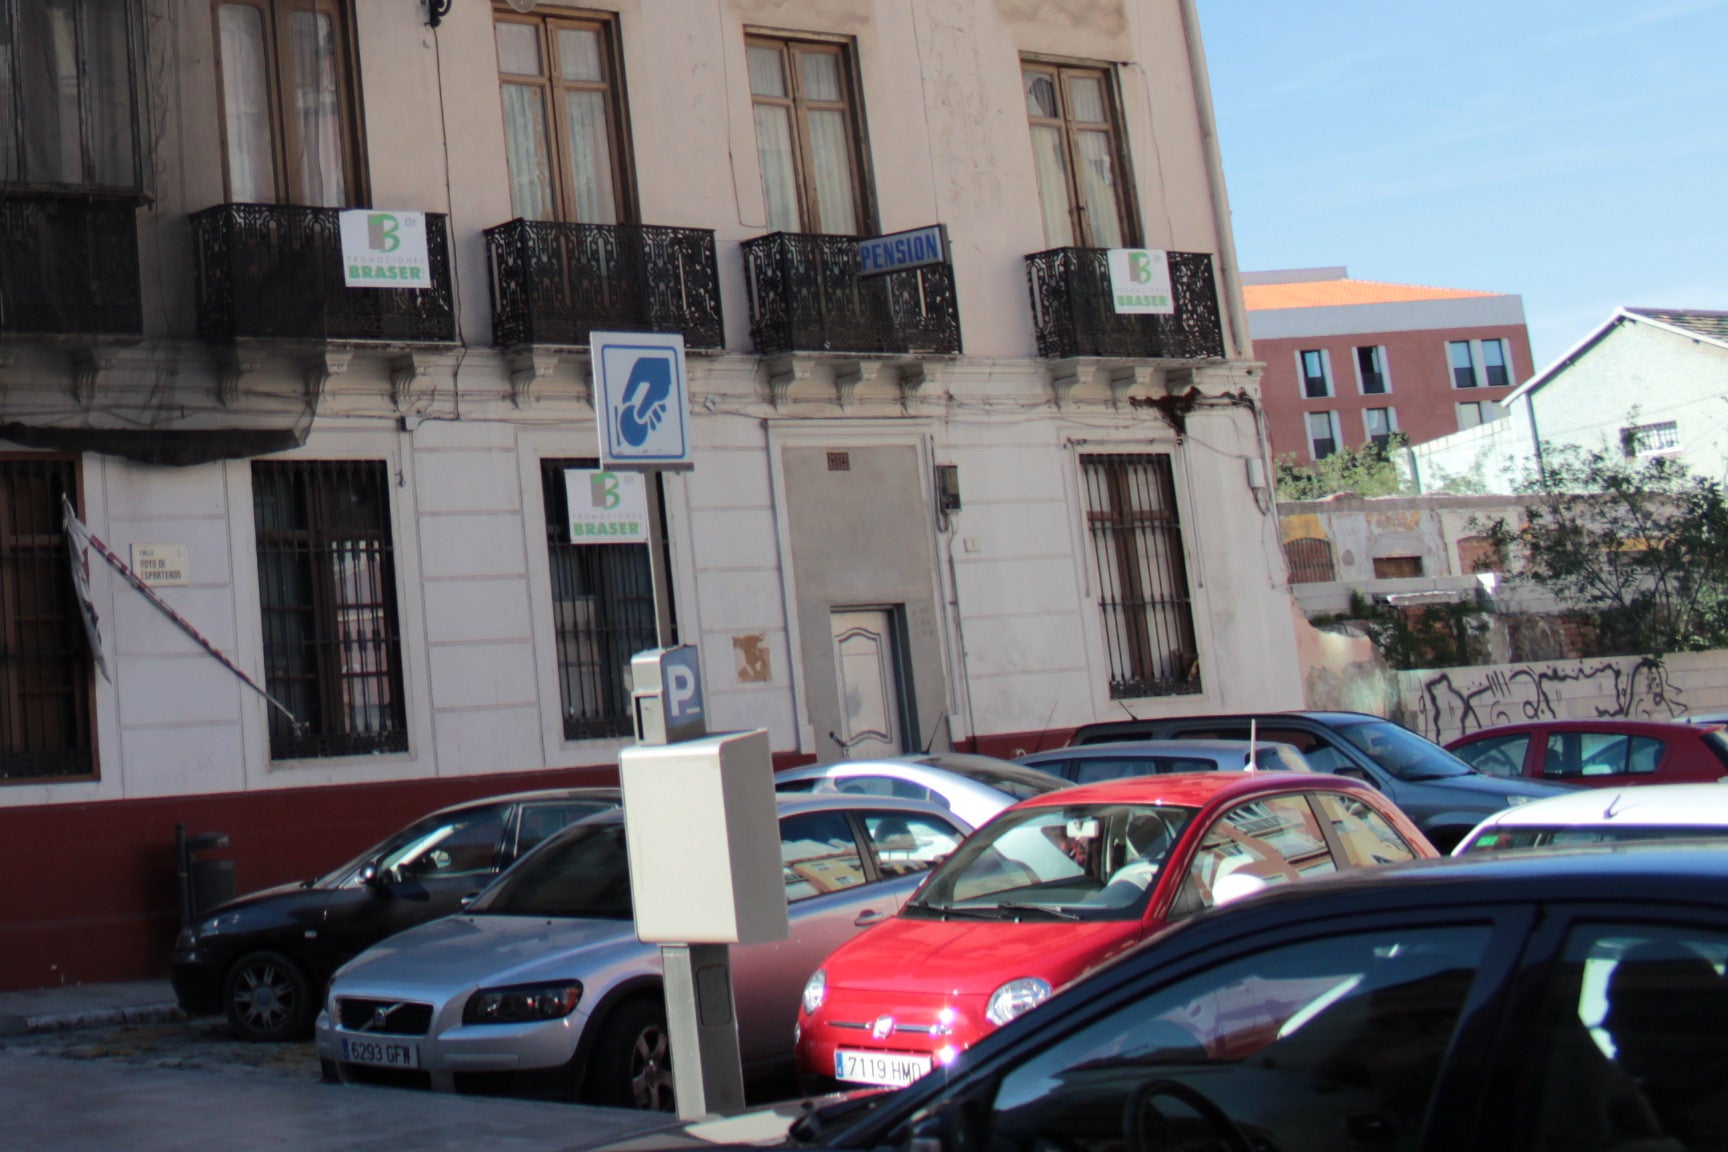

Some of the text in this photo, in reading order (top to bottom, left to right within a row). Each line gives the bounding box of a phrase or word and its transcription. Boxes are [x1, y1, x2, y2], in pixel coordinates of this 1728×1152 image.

[860, 234, 940, 271] PENSION
[348, 265, 422, 281] BRASER
[1117, 295, 1168, 307] BRASER
[574, 522, 640, 537] BRASER
[667, 664, 695, 717] P
[351, 1041, 411, 1065] 6293 GFW
[848, 1056, 887, 1080] 7119
